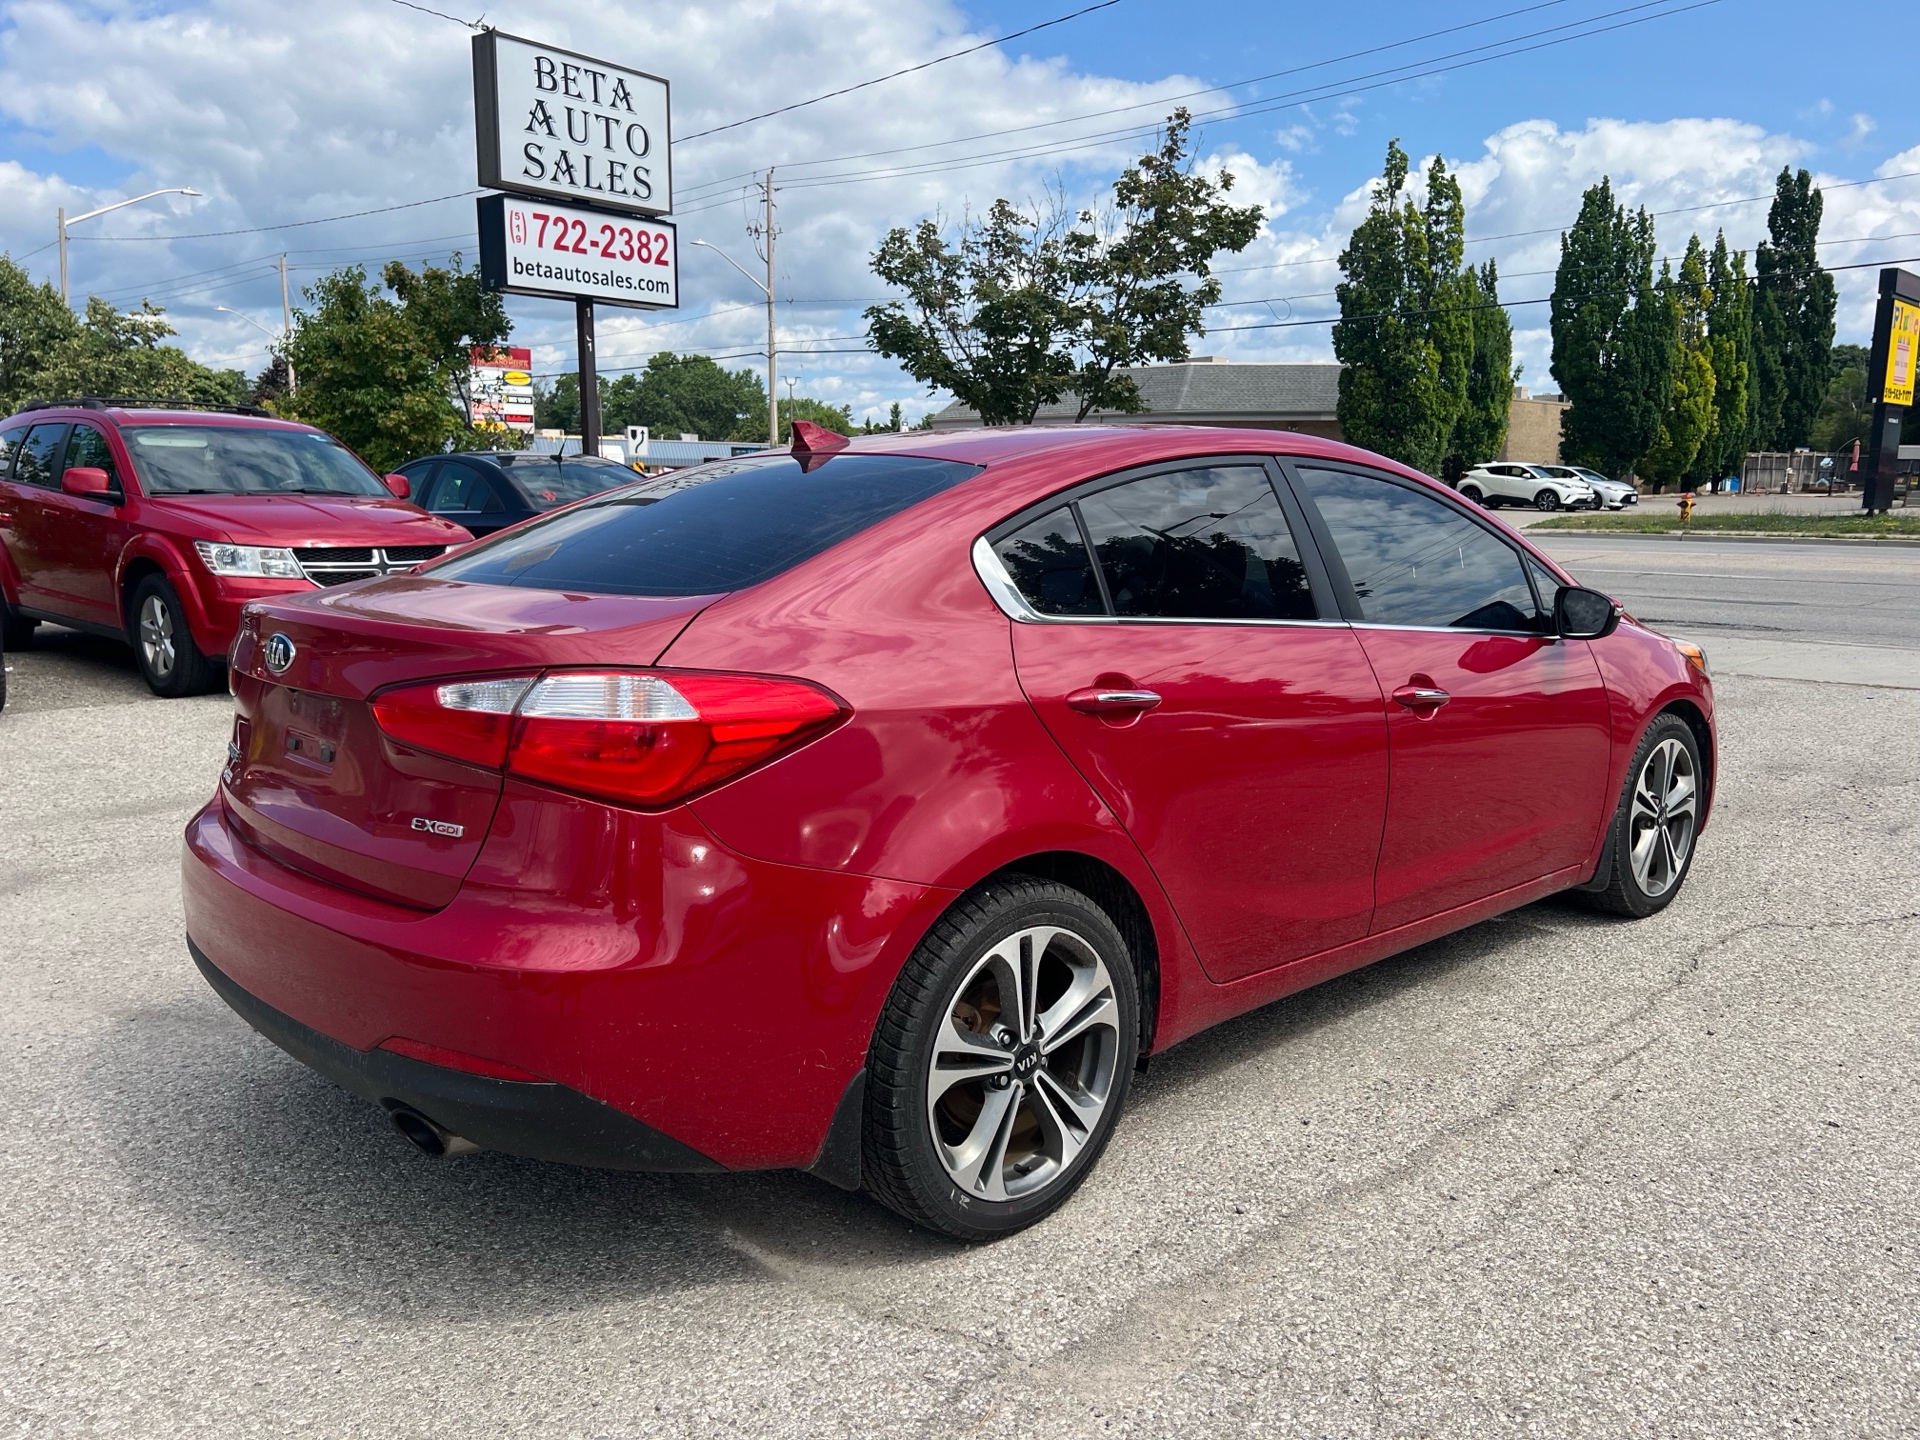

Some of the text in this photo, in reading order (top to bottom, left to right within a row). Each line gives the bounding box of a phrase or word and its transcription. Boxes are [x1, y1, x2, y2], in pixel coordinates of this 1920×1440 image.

[534, 56, 637, 115] BETA
[524, 98, 651, 159] AUTO
[523, 142, 654, 201] SALES
[532, 212, 669, 266] 722-2382
[513, 256, 670, 294] betaautosales.com
[267, 641, 286, 666] KIA
[1017, 1052, 1037, 1072] KIA
